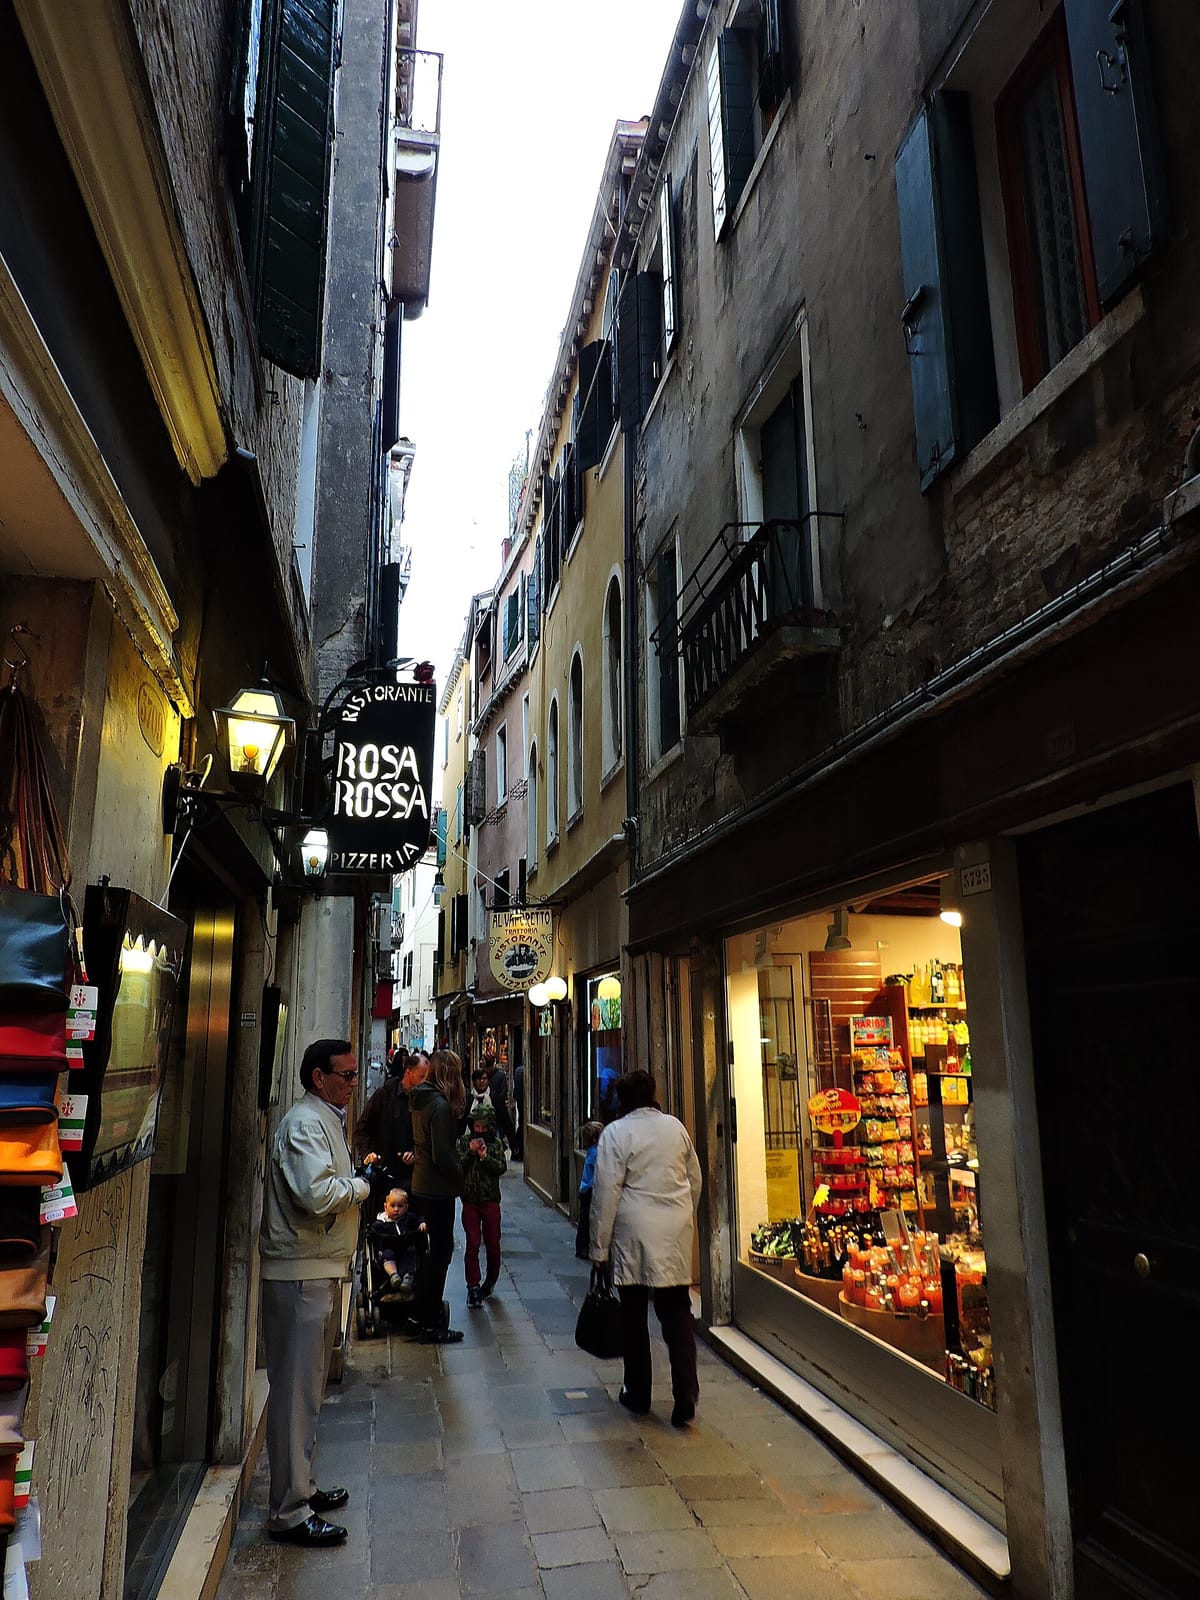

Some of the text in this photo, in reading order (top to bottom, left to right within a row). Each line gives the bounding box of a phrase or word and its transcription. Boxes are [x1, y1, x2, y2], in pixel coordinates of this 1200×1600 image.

[342, 685, 433, 722] RISTORANTE
[336, 742, 420, 782] ROSA
[333, 780, 428, 820] ROSSA
[330, 843, 420, 869] PIZZERIA
[493, 914, 502, 928] AL
[495, 935, 546, 960] RISTORANTE
[498, 971, 544, 988] PIZZERIA
[854, 1019, 885, 1028] HARIBO
